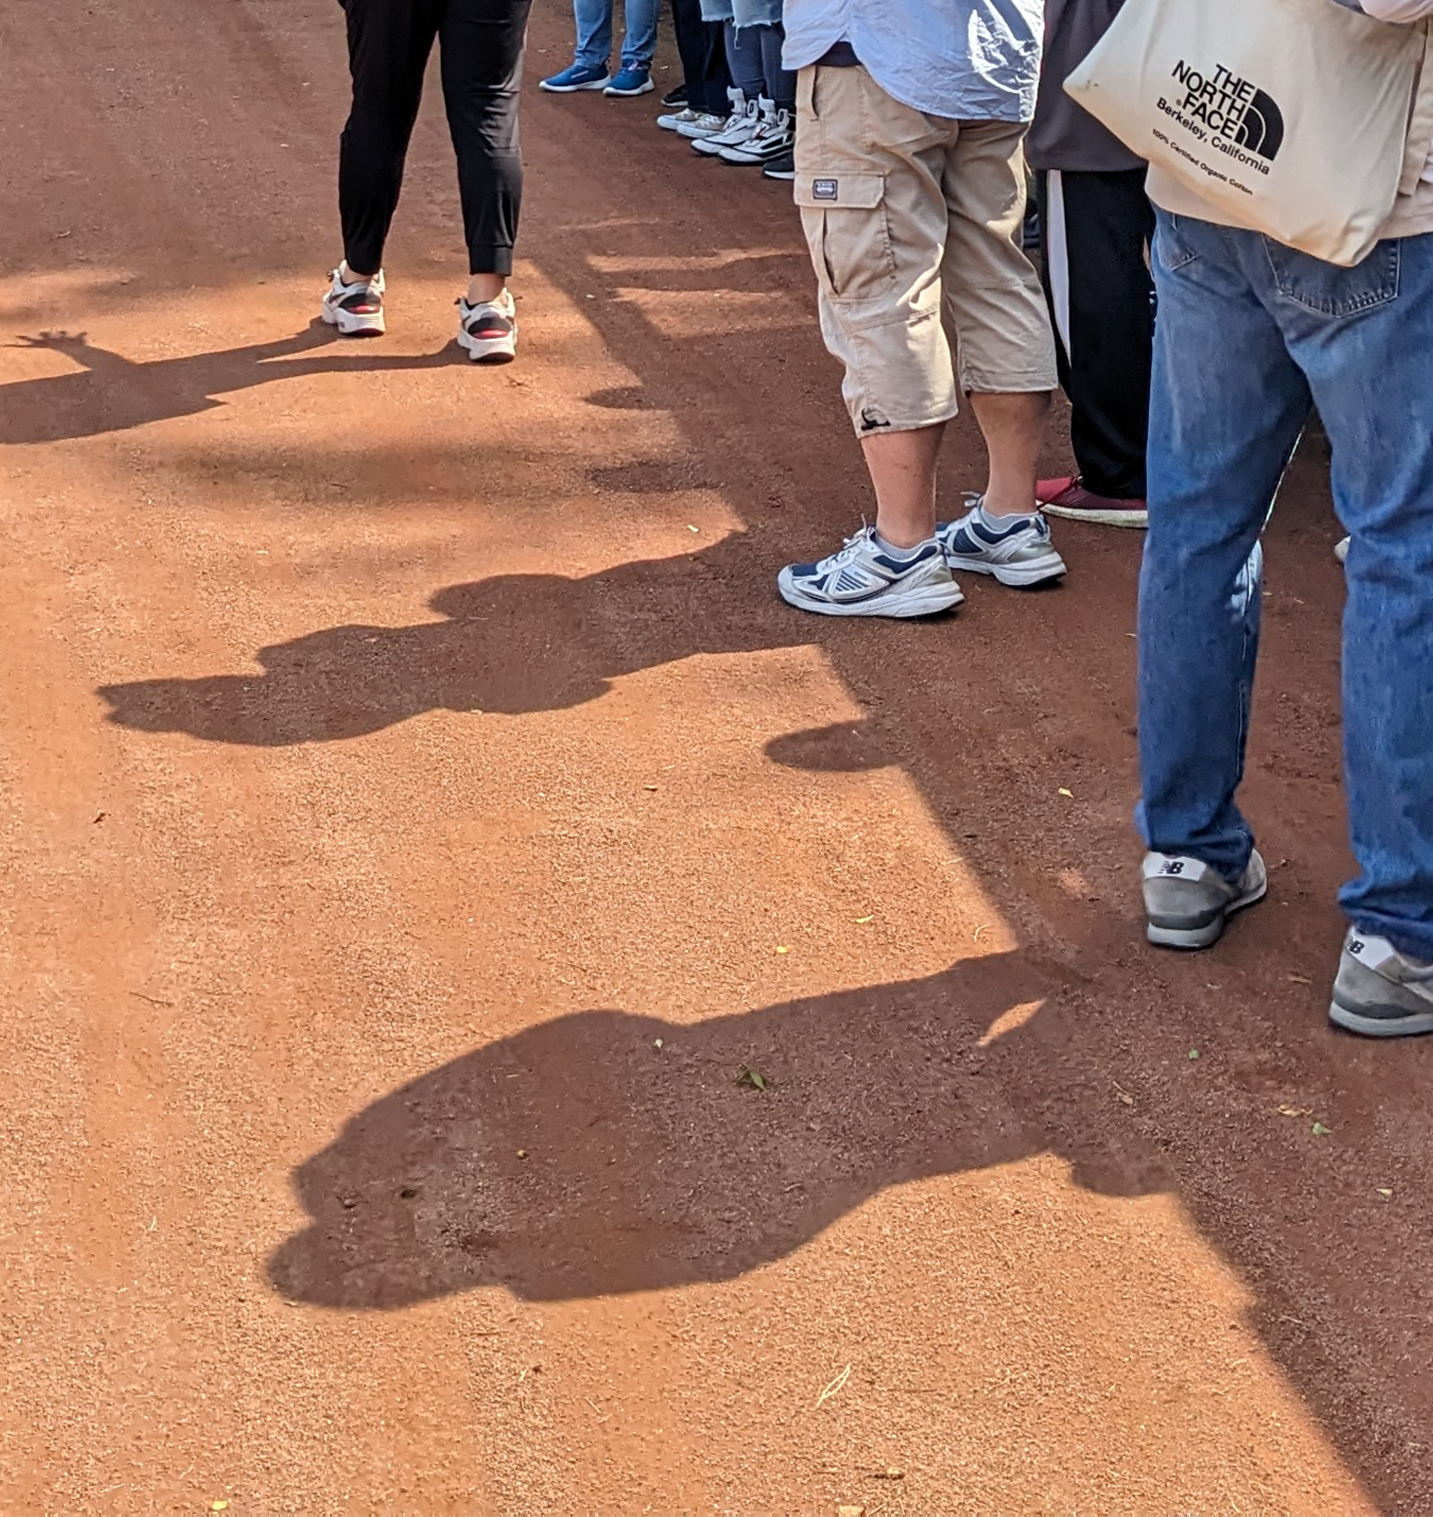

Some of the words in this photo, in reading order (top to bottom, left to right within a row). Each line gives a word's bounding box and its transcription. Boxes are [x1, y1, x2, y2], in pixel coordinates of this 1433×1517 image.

[1171, 59, 1246, 121] NORTH
[1213, 63, 1255, 103] THE
[1157, 97, 1208, 143] Berkeley,
[1211, 136, 1270, 175] California
[1182, 91, 1238, 140] FACE
[1152, 128, 1169, 144] 100%
[1170, 141, 1200, 166] Certified
[1200, 162, 1228, 182] Organic
[1228, 178, 1253, 195] Cotton
